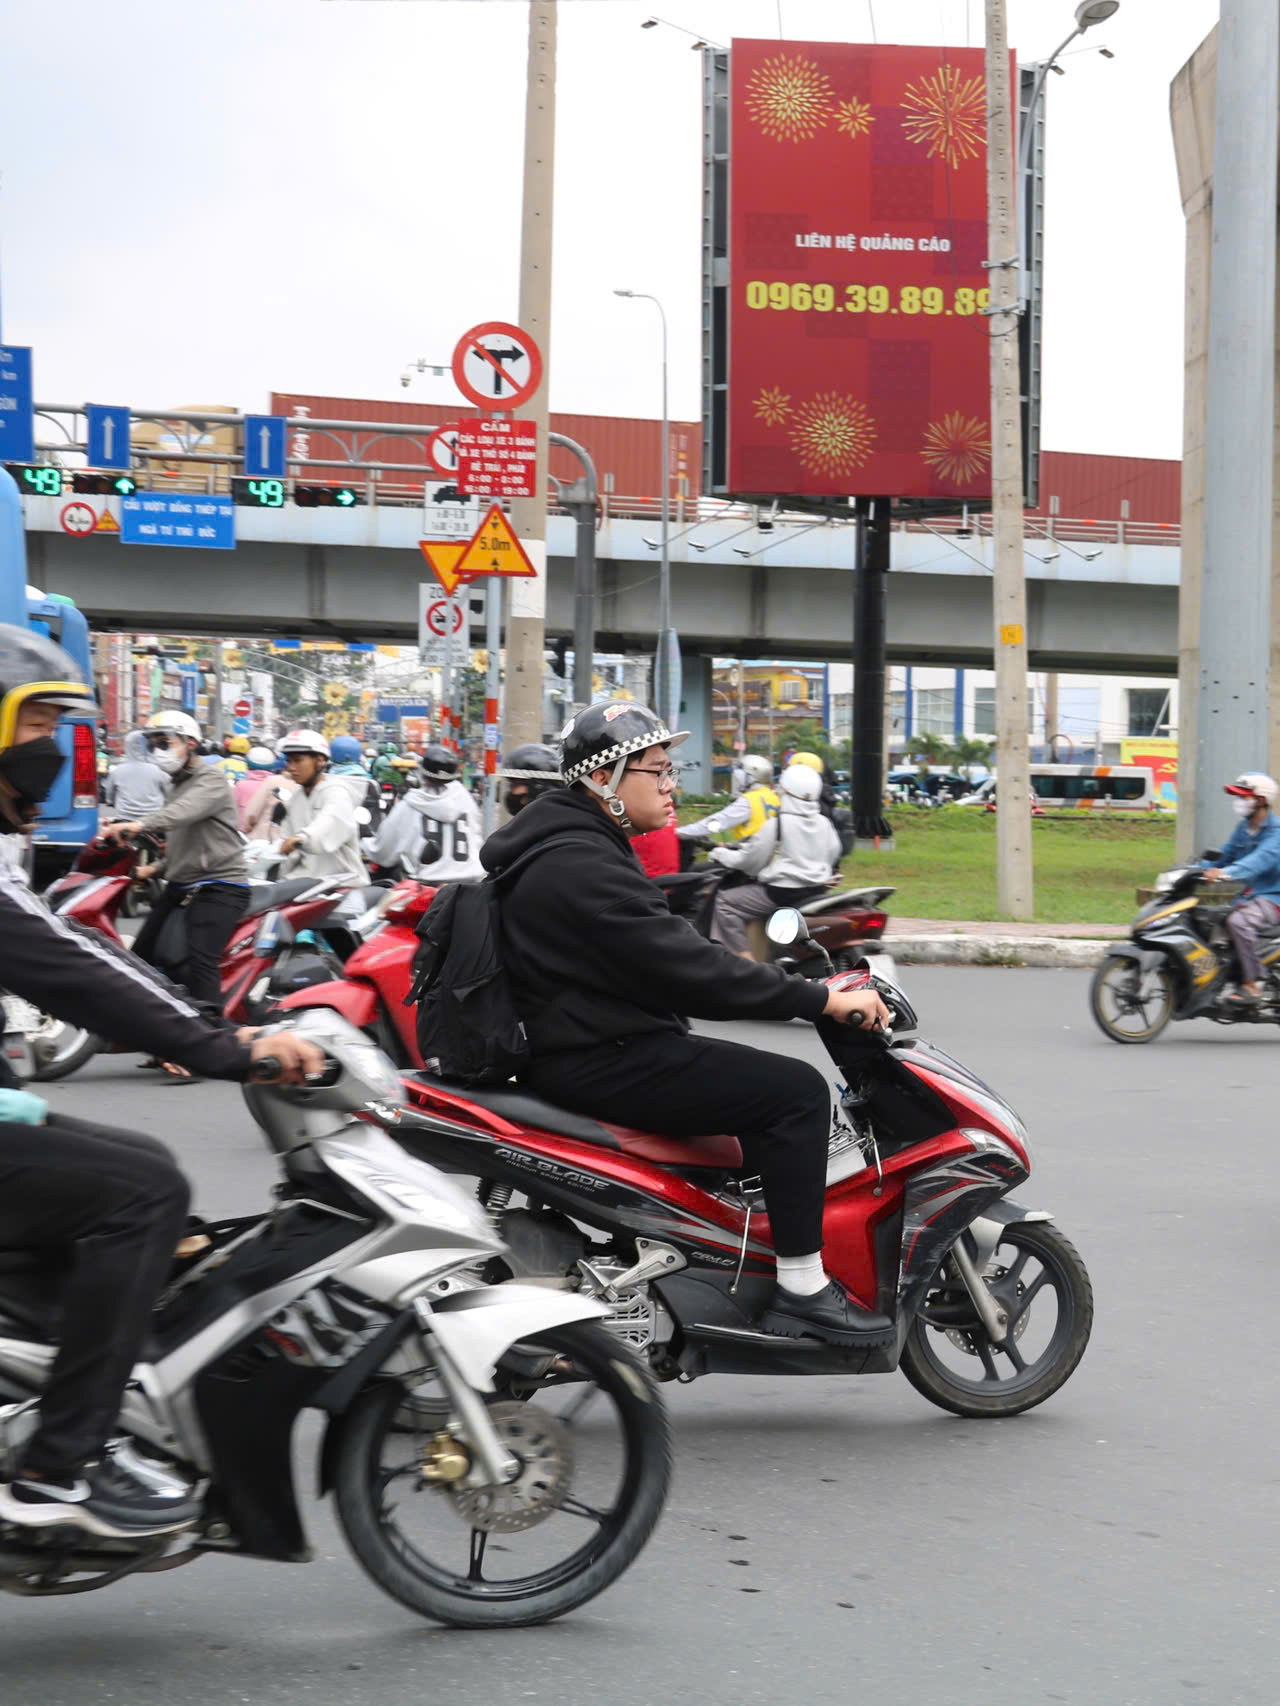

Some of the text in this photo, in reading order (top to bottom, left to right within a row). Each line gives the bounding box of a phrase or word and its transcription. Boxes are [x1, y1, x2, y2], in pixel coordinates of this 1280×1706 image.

[795, 232, 951, 252] LIÊN HỆ QUẢNG CÁO
[480, 420, 511, 432] CẤM
[23, 467, 61, 495] 49
[248, 479, 284, 507] 49
[479, 537, 511, 552] 5.0m
[429, 586, 460, 599] ZOE
[494, 1148, 610, 1190] AIR BLADE
